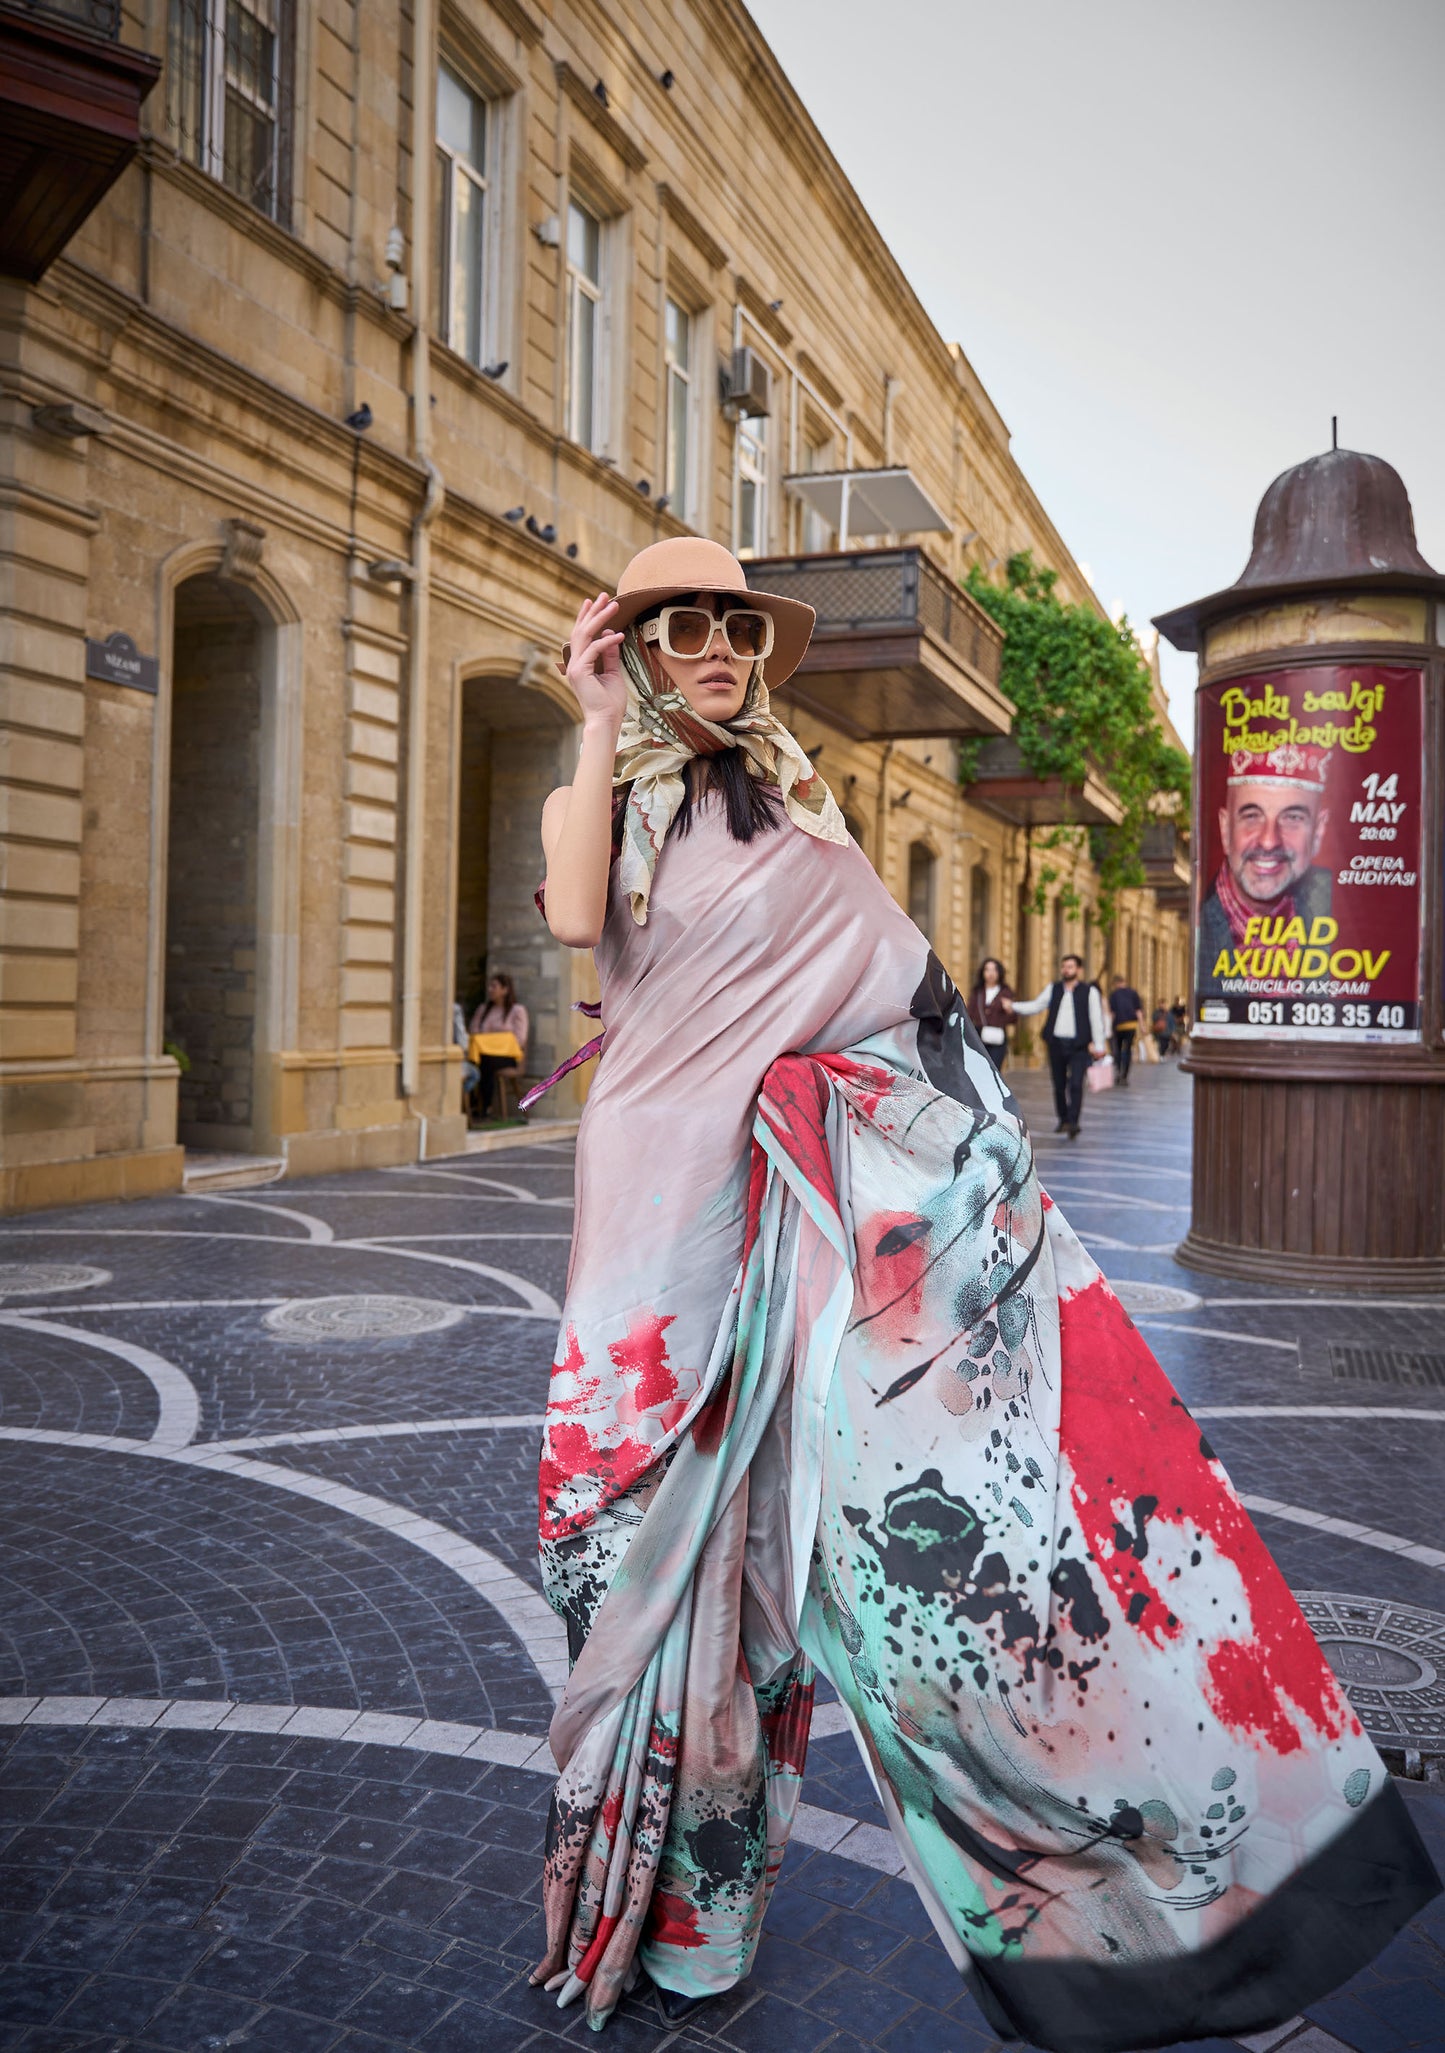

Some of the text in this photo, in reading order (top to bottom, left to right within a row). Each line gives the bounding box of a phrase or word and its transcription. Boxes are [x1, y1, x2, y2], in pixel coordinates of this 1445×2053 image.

[1220, 680, 1385, 727] Bakı sevgi
[1361, 772, 1399, 802] 14
[1349, 801, 1407, 824] MAY
[1358, 826, 1397, 841] 20:00
[1350, 855, 1405, 871] OPERA
[1243, 915, 1339, 946] FUAD
[1212, 948, 1392, 981] AXUNDOV
[1305, 980, 1371, 997] AXŞAMI
[1247, 1001, 1405, 1028] 051 303 35 40
